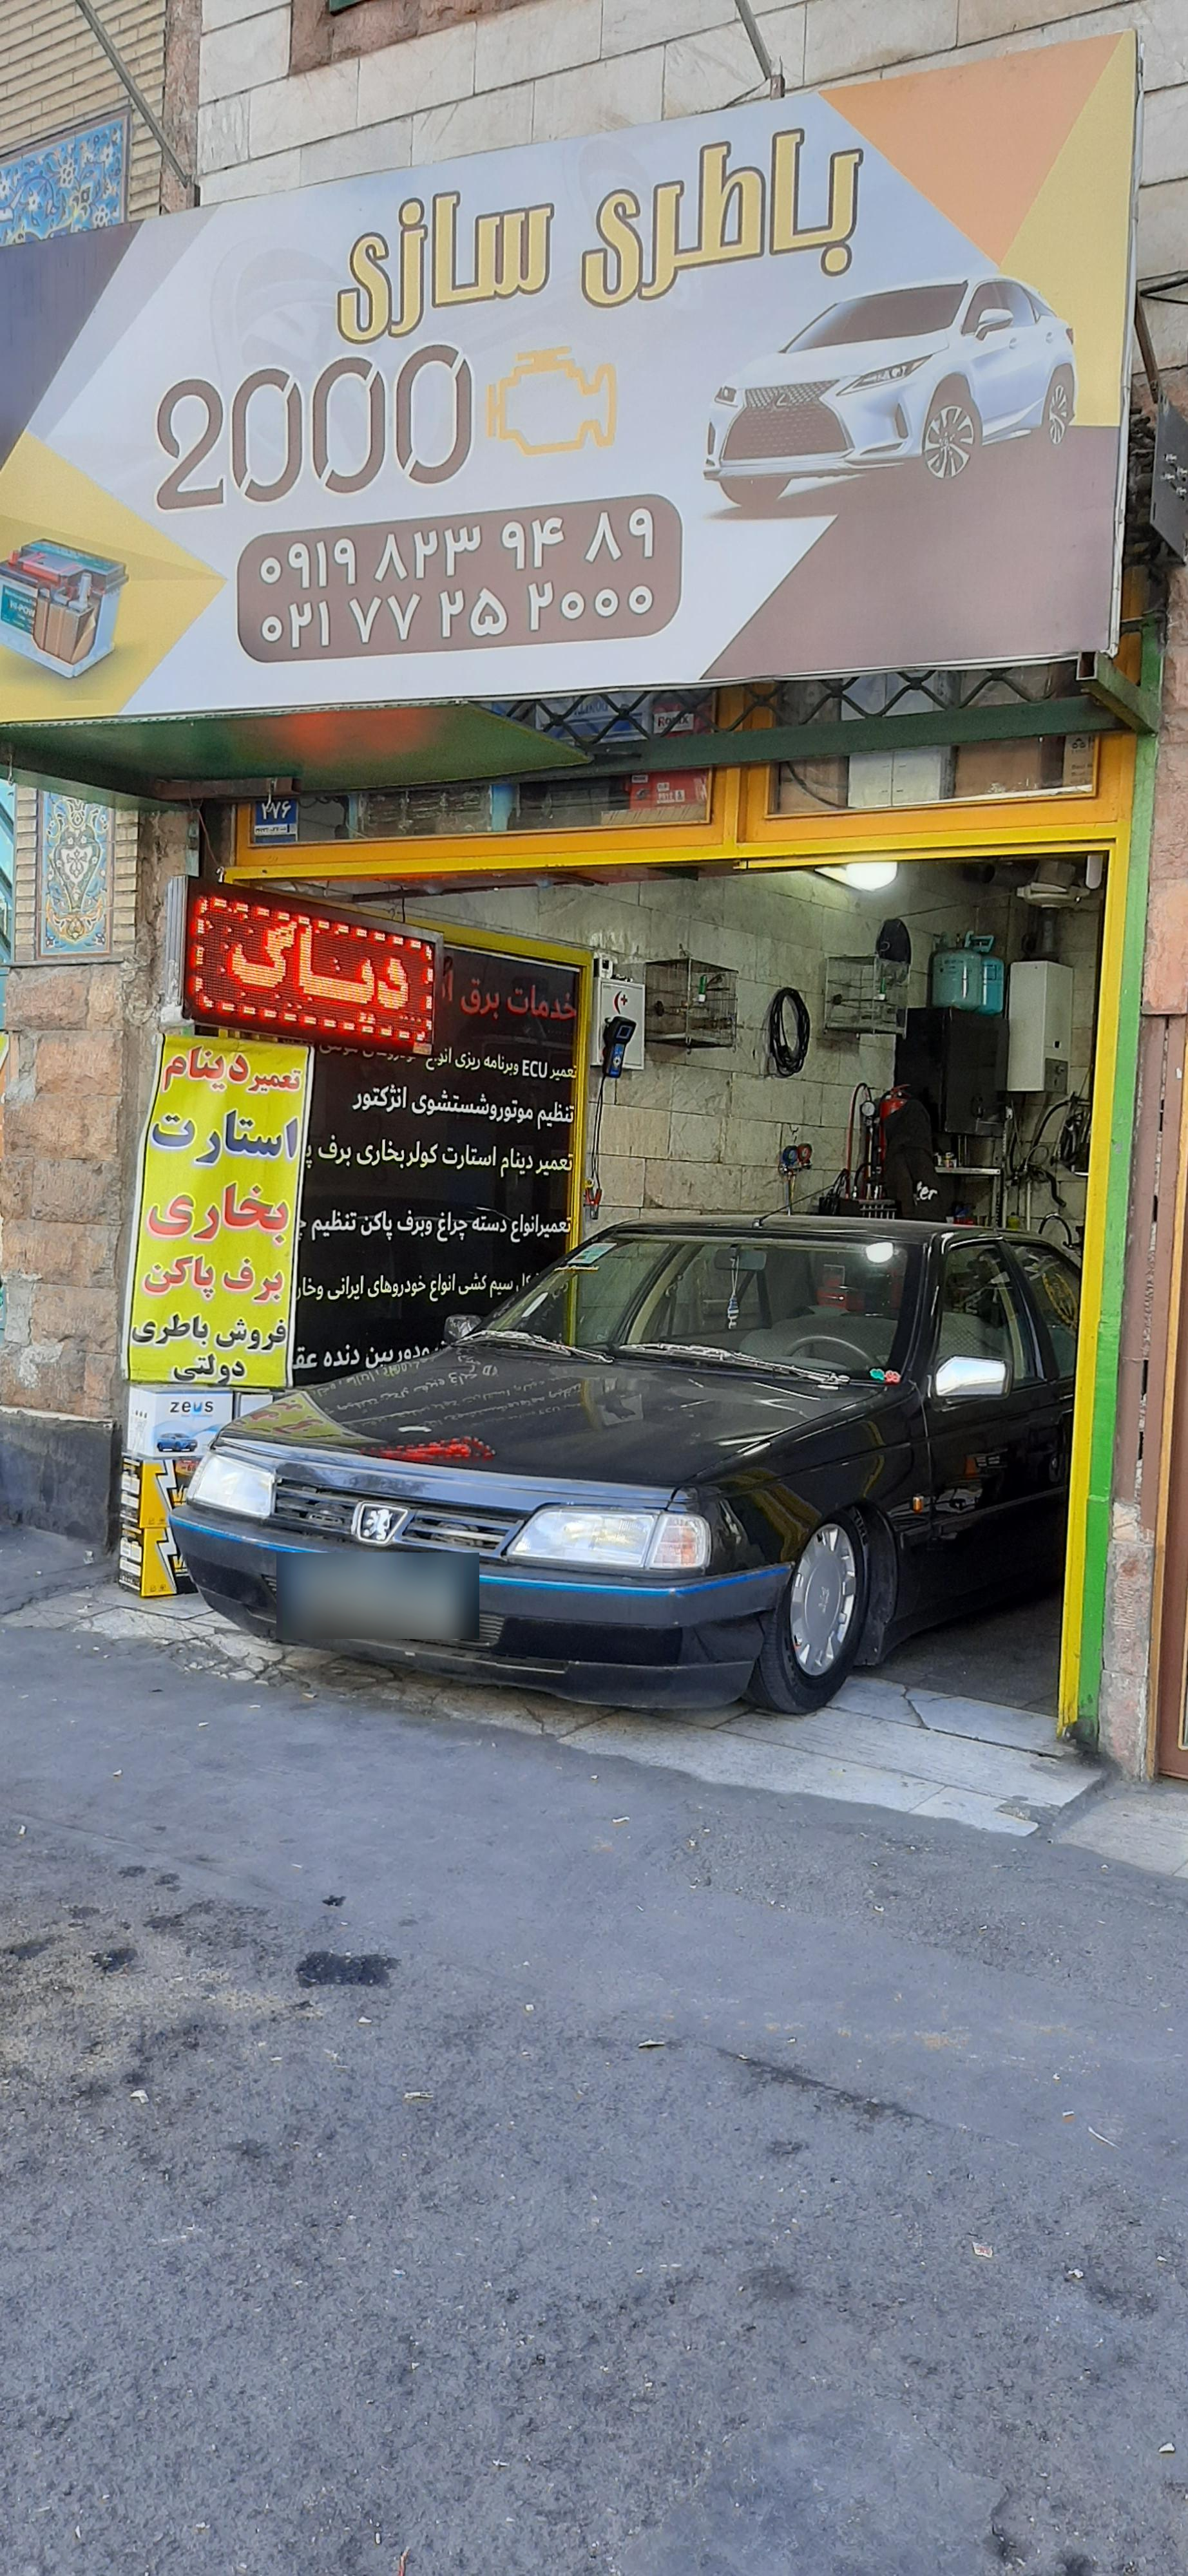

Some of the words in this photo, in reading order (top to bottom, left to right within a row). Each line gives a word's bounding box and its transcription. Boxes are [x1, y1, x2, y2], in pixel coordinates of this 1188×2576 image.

[582, 128, 864, 308] باطری
[337, 191, 555, 345] سازی
[155, 344, 474, 511] 2000
[259, 536, 357, 589] ۰۹۱۹
[375, 525, 481, 583] ۸۲۳
[502, 516, 565, 571] ۹۴
[586, 507, 655, 562] ۸۹
[260, 597, 331, 649] ۰۲۱
[348, 592, 421, 643] ۷۷
[440, 587, 509, 639] ۲۵
[529, 580, 655, 632] ۲۰۰۰
[262, 800, 291, 820] ۲۷۶
[461, 978, 499, 1019] برق
[507, 985, 577, 1020] خدمات
[162, 1045, 249, 1092] دینام
[455, 1051, 481, 1070] ریزی
[522, 1060, 548, 1078] ECU
[249, 1070, 301, 1092] تعمیر
[352, 1084, 407, 1112] انژکتور
[537, 1103, 575, 1131] تنظیم
[150, 1110, 299, 1165] استارت
[318, 1135, 352, 1166] برف
[442, 1144, 496, 1168] استارت
[501, 1148, 533, 1178] دینام
[536, 1151, 572, 1175] تعمیر
[148, 1182, 289, 1245] بخاری
[311, 1210, 357, 1240] تنظیم
[360, 1211, 393, 1241] پاکن
[437, 1211, 468, 1242] چراغ
[472, 1214, 507, 1234] دسته
[143, 1255, 215, 1301] پاکن
[224, 1257, 283, 1303] برف
[296, 1277, 323, 1301] وخار
[327, 1275, 364, 1302] ایرانی
[367, 1276, 426, 1298] خودروهای
[430, 1273, 455, 1302] انواع
[457, 1272, 488, 1295] کشی
[489, 1281, 513, 1298] سیم
[131, 1313, 208, 1345] باطری
[216, 1318, 287, 1352] فروش
[173, 1354, 245, 1386] دولتی
[292, 1347, 318, 1369] عق
[323, 1344, 360, 1367] دنده
[169, 1401, 214, 1414] zeus
